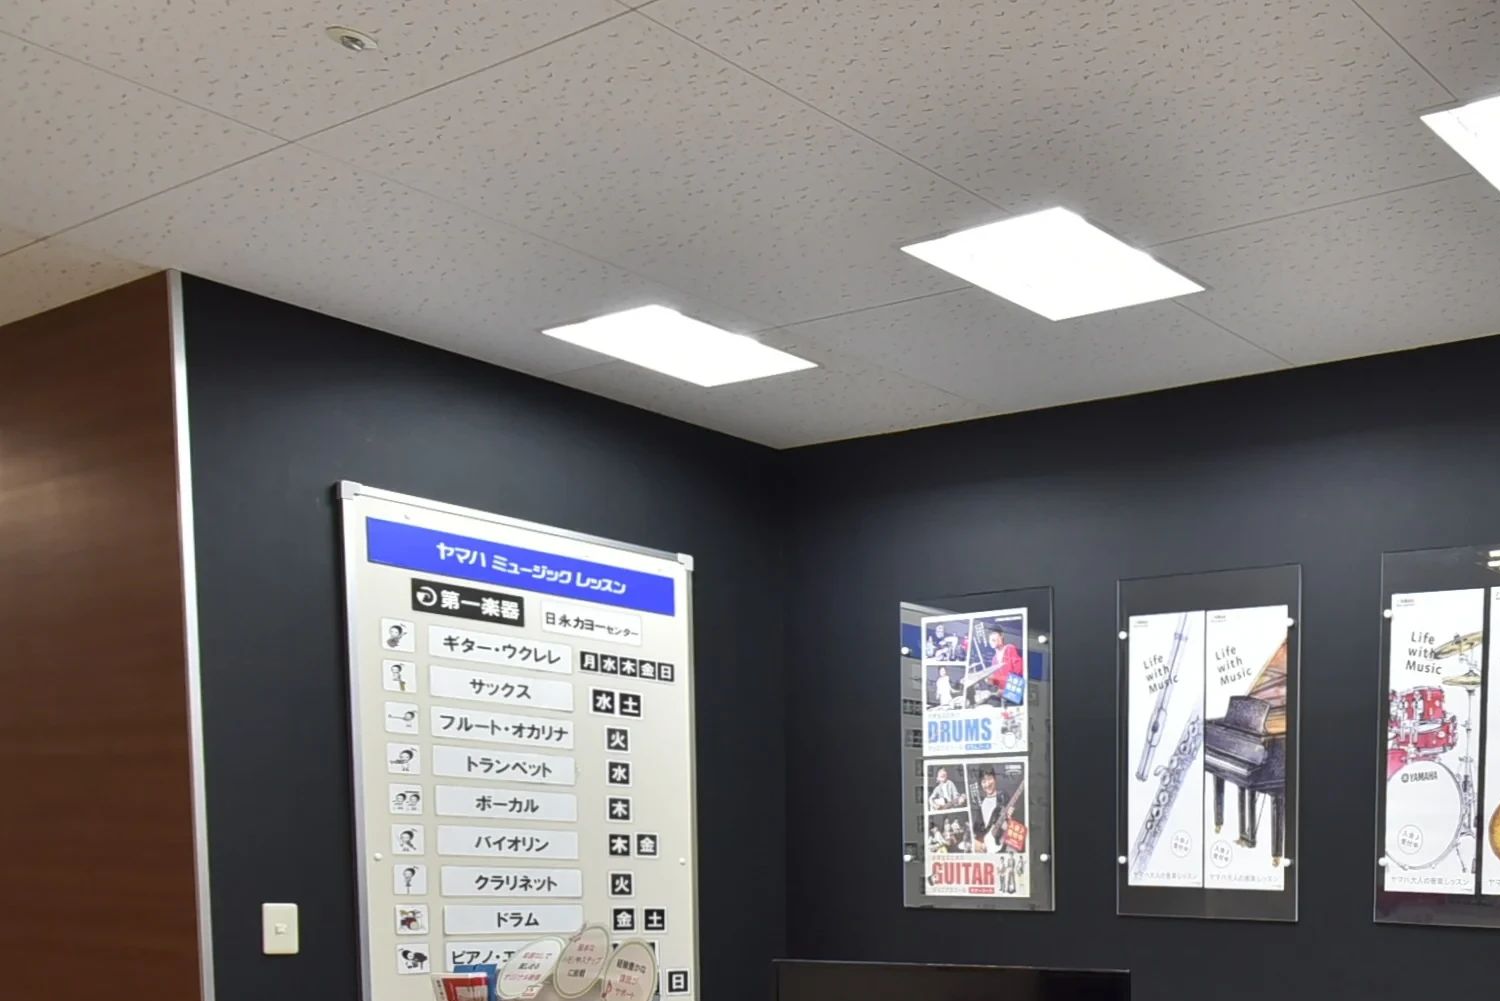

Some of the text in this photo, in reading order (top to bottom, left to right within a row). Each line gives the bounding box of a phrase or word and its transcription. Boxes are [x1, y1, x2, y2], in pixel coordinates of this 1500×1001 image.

[437, 543, 627, 596] ヤマハ ミュージック レッスン
[440, 590, 520, 621] 第一楽器
[545, 611, 639, 638] 日永カヨーセンター
[1411, 631, 1436, 645] Life
[443, 635, 561, 666] ギター・ウクレレ
[1215, 645, 1237, 661] Life
[1407, 647, 1438, 660] with
[1143, 654, 1163, 670] Life
[1217, 656, 1243, 674] with
[1405, 659, 1442, 676] Music
[1145, 664, 1170, 682] with
[1220, 668, 1252, 687] Music
[470, 678, 532, 700] サックス
[1148, 674, 1179, 695] Music
[440, 715, 568, 743] フルート・オカリナ
[928, 718, 992, 743] DRUMS
[610, 730, 628, 749] 火
[466, 756, 552, 778] トランペット
[610, 761, 630, 783] 水
[1410, 771, 1438, 783] YAMAHA
[475, 795, 539, 813] ボーカル
[611, 797, 629, 817] 木
[475, 835, 549, 852] バイオリン
[932, 862, 994, 885] GUITAR
[475, 875, 558, 892] クラリネット
[612, 875, 631, 894] 火
[496, 911, 540, 928] ドラム
[670, 971, 688, 992] 日
